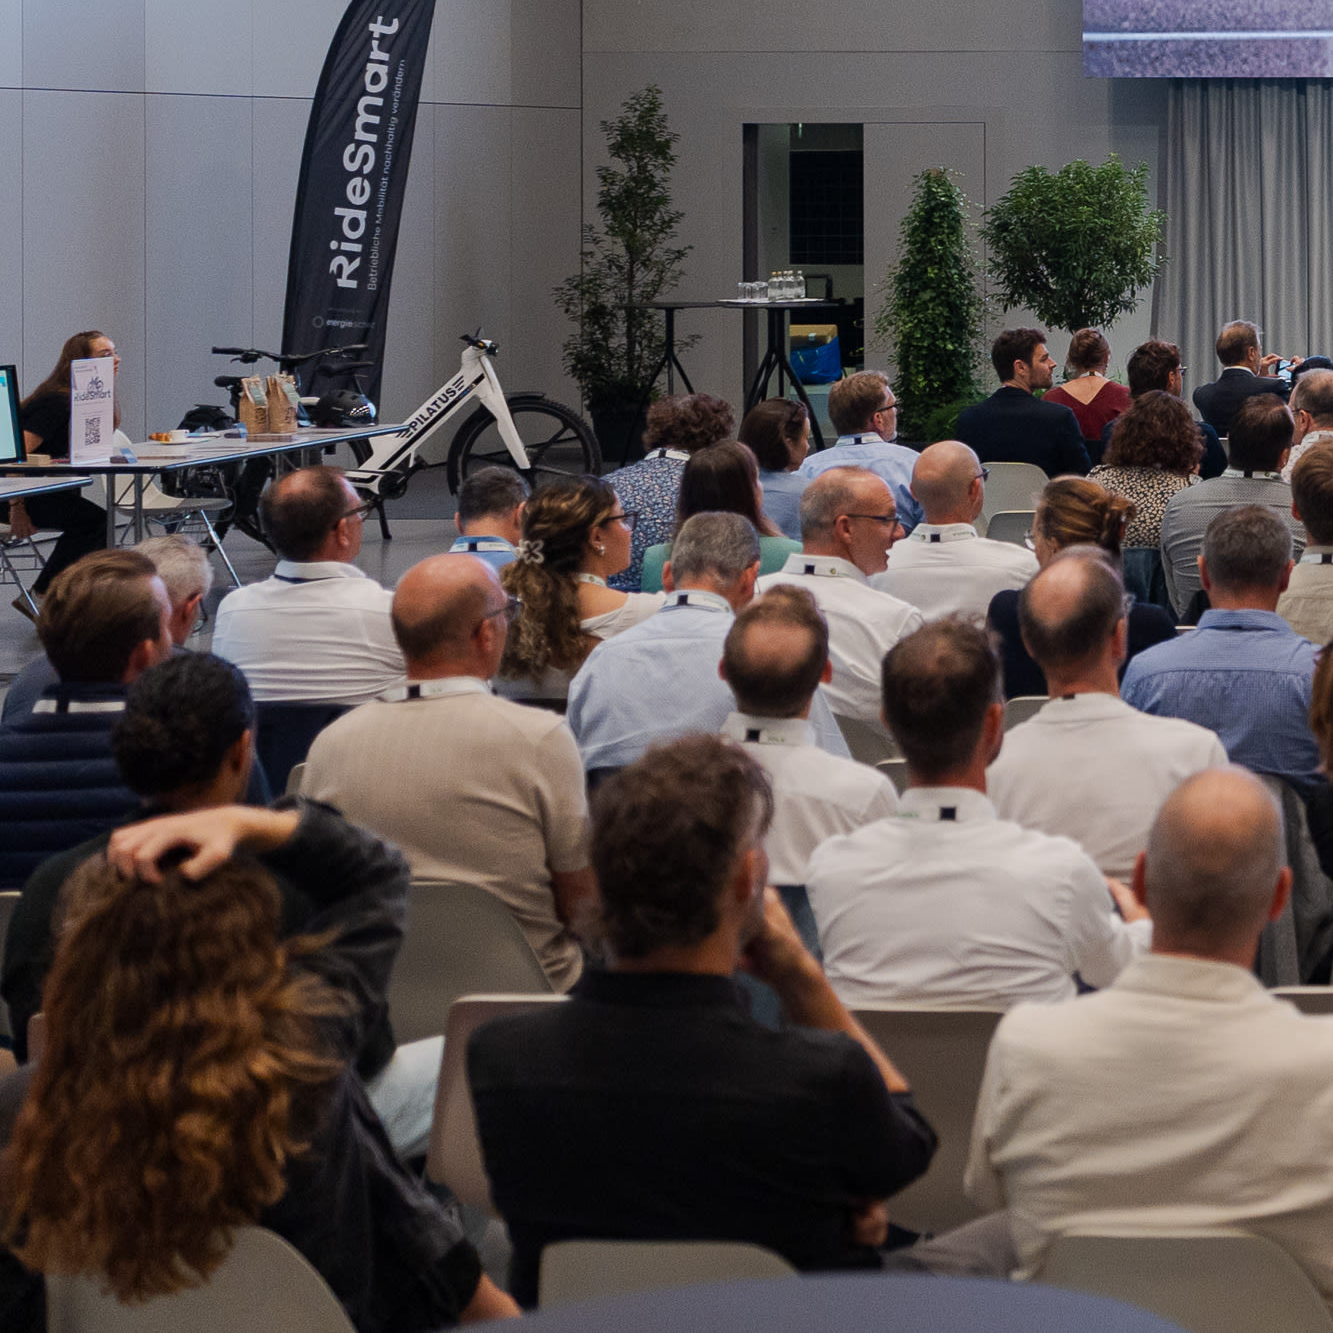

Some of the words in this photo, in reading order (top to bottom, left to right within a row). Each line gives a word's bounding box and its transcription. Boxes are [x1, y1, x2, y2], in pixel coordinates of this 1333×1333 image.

[329, 16, 399, 288] RideSmart
[367, 226, 381, 290] Betriebliche
[376, 177, 389, 224] Mobilität
[384, 116, 398, 174] nachhaltig
[392, 59, 406, 114] verändern
[409, 386, 457, 431] PILATUS
